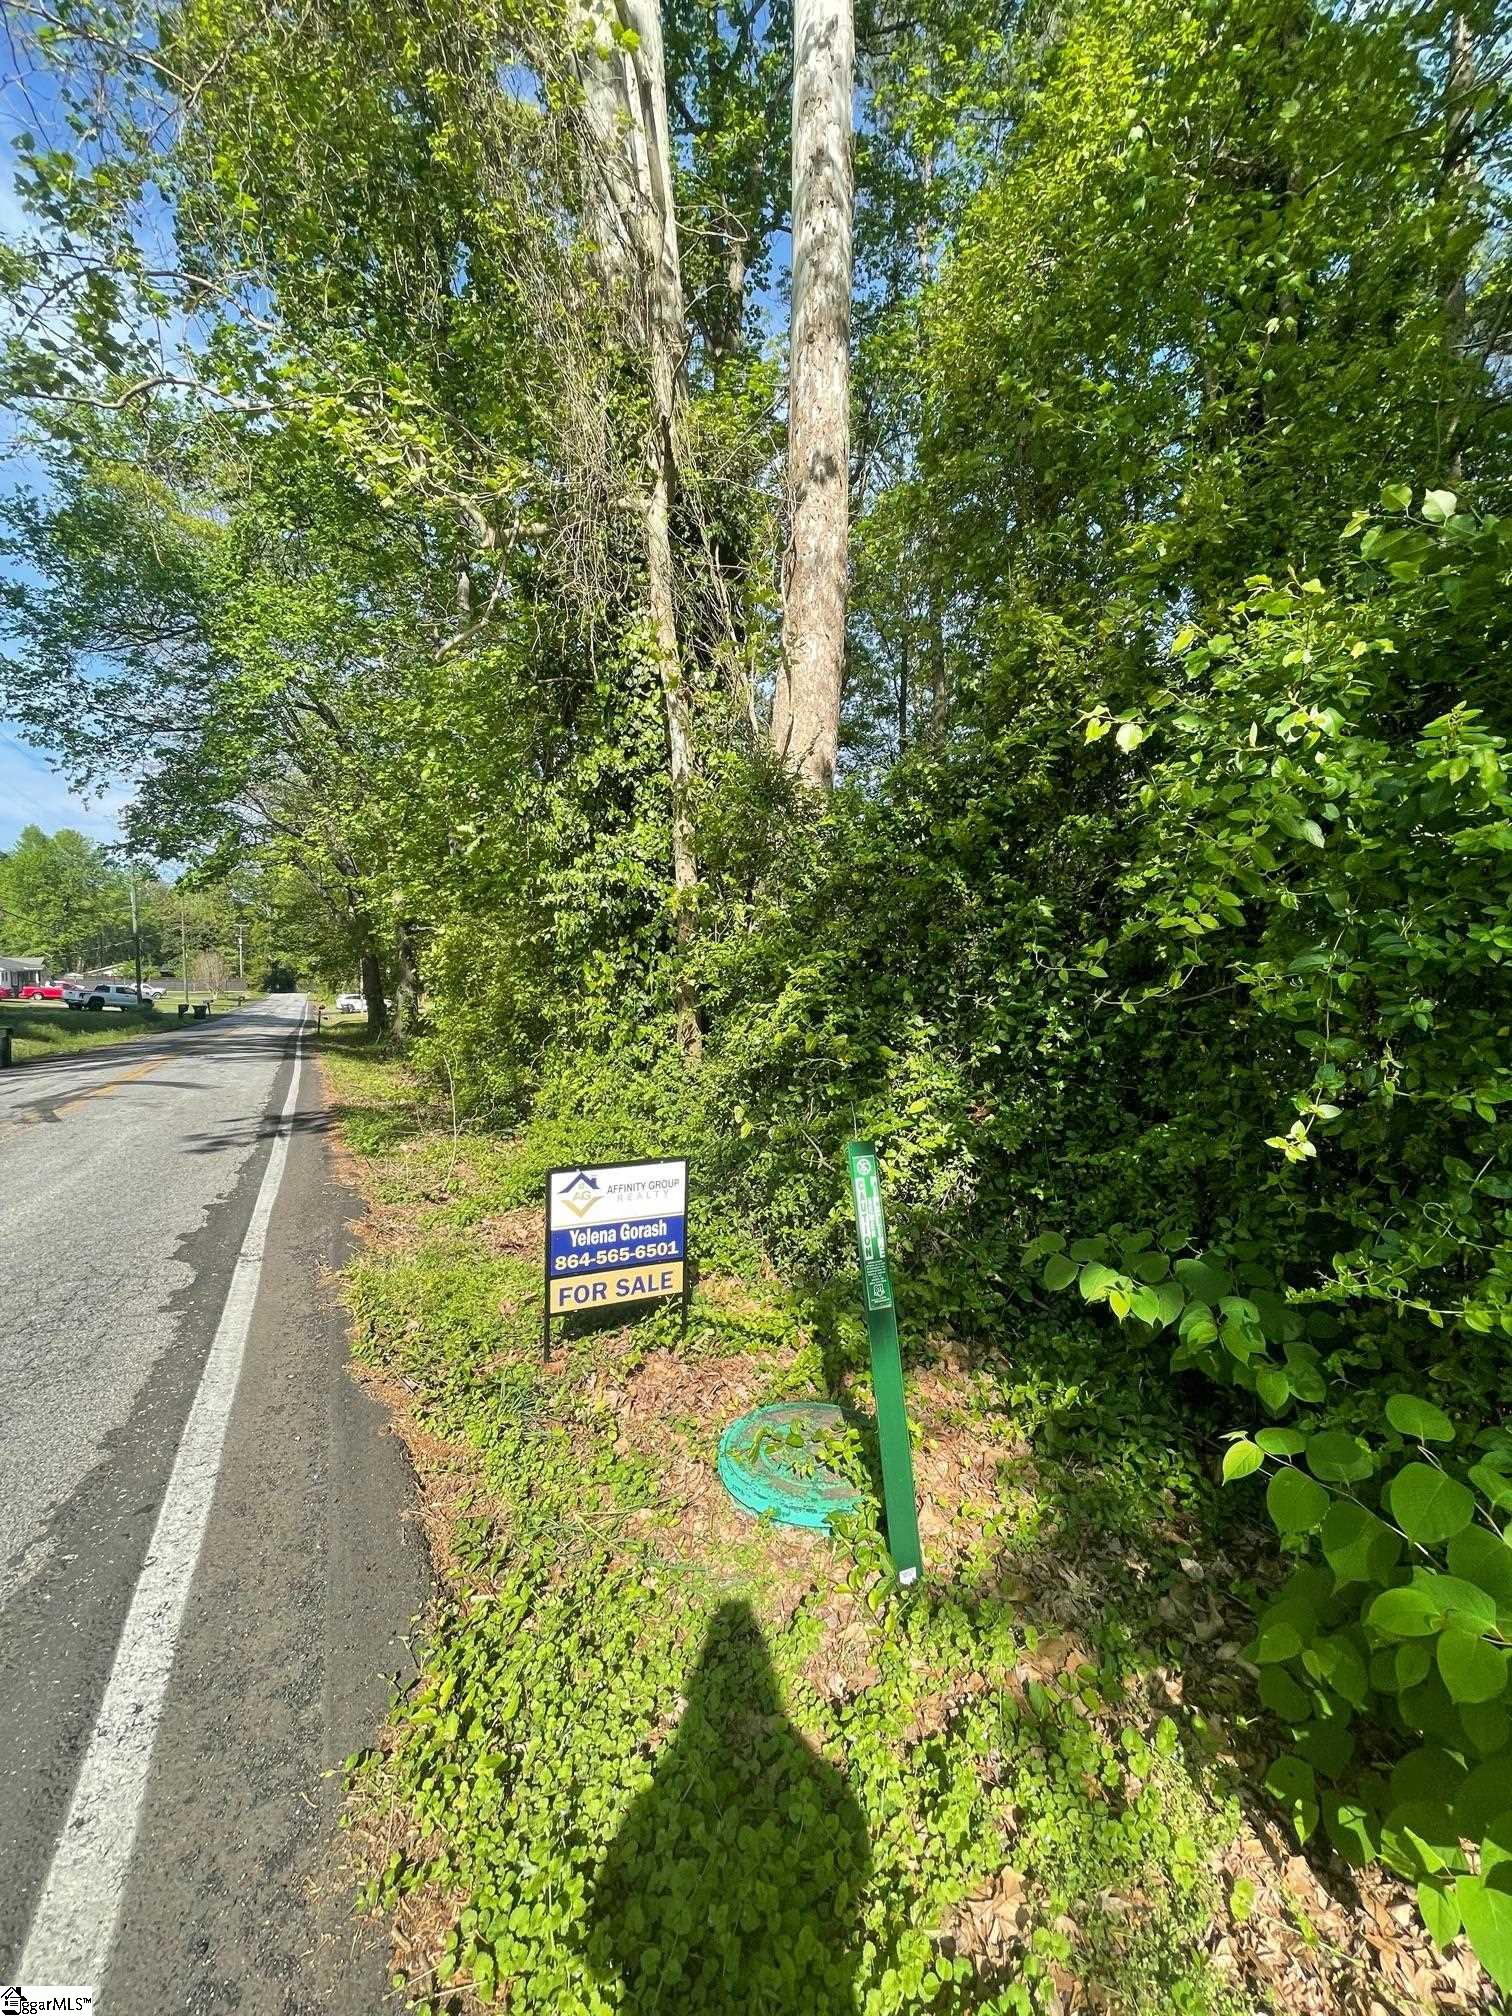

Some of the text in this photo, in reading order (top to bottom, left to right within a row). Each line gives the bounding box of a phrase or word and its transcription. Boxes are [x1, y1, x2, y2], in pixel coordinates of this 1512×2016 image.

[608, 1179, 680, 1194] AFFINITY GROUP
[570, 1219, 667, 1247] Yelena Gorash
[858, 1181, 872, 1257] CAUTION
[555, 1241, 678, 1270] 864-565-6501
[559, 1271, 673, 1306] FOR SALE
